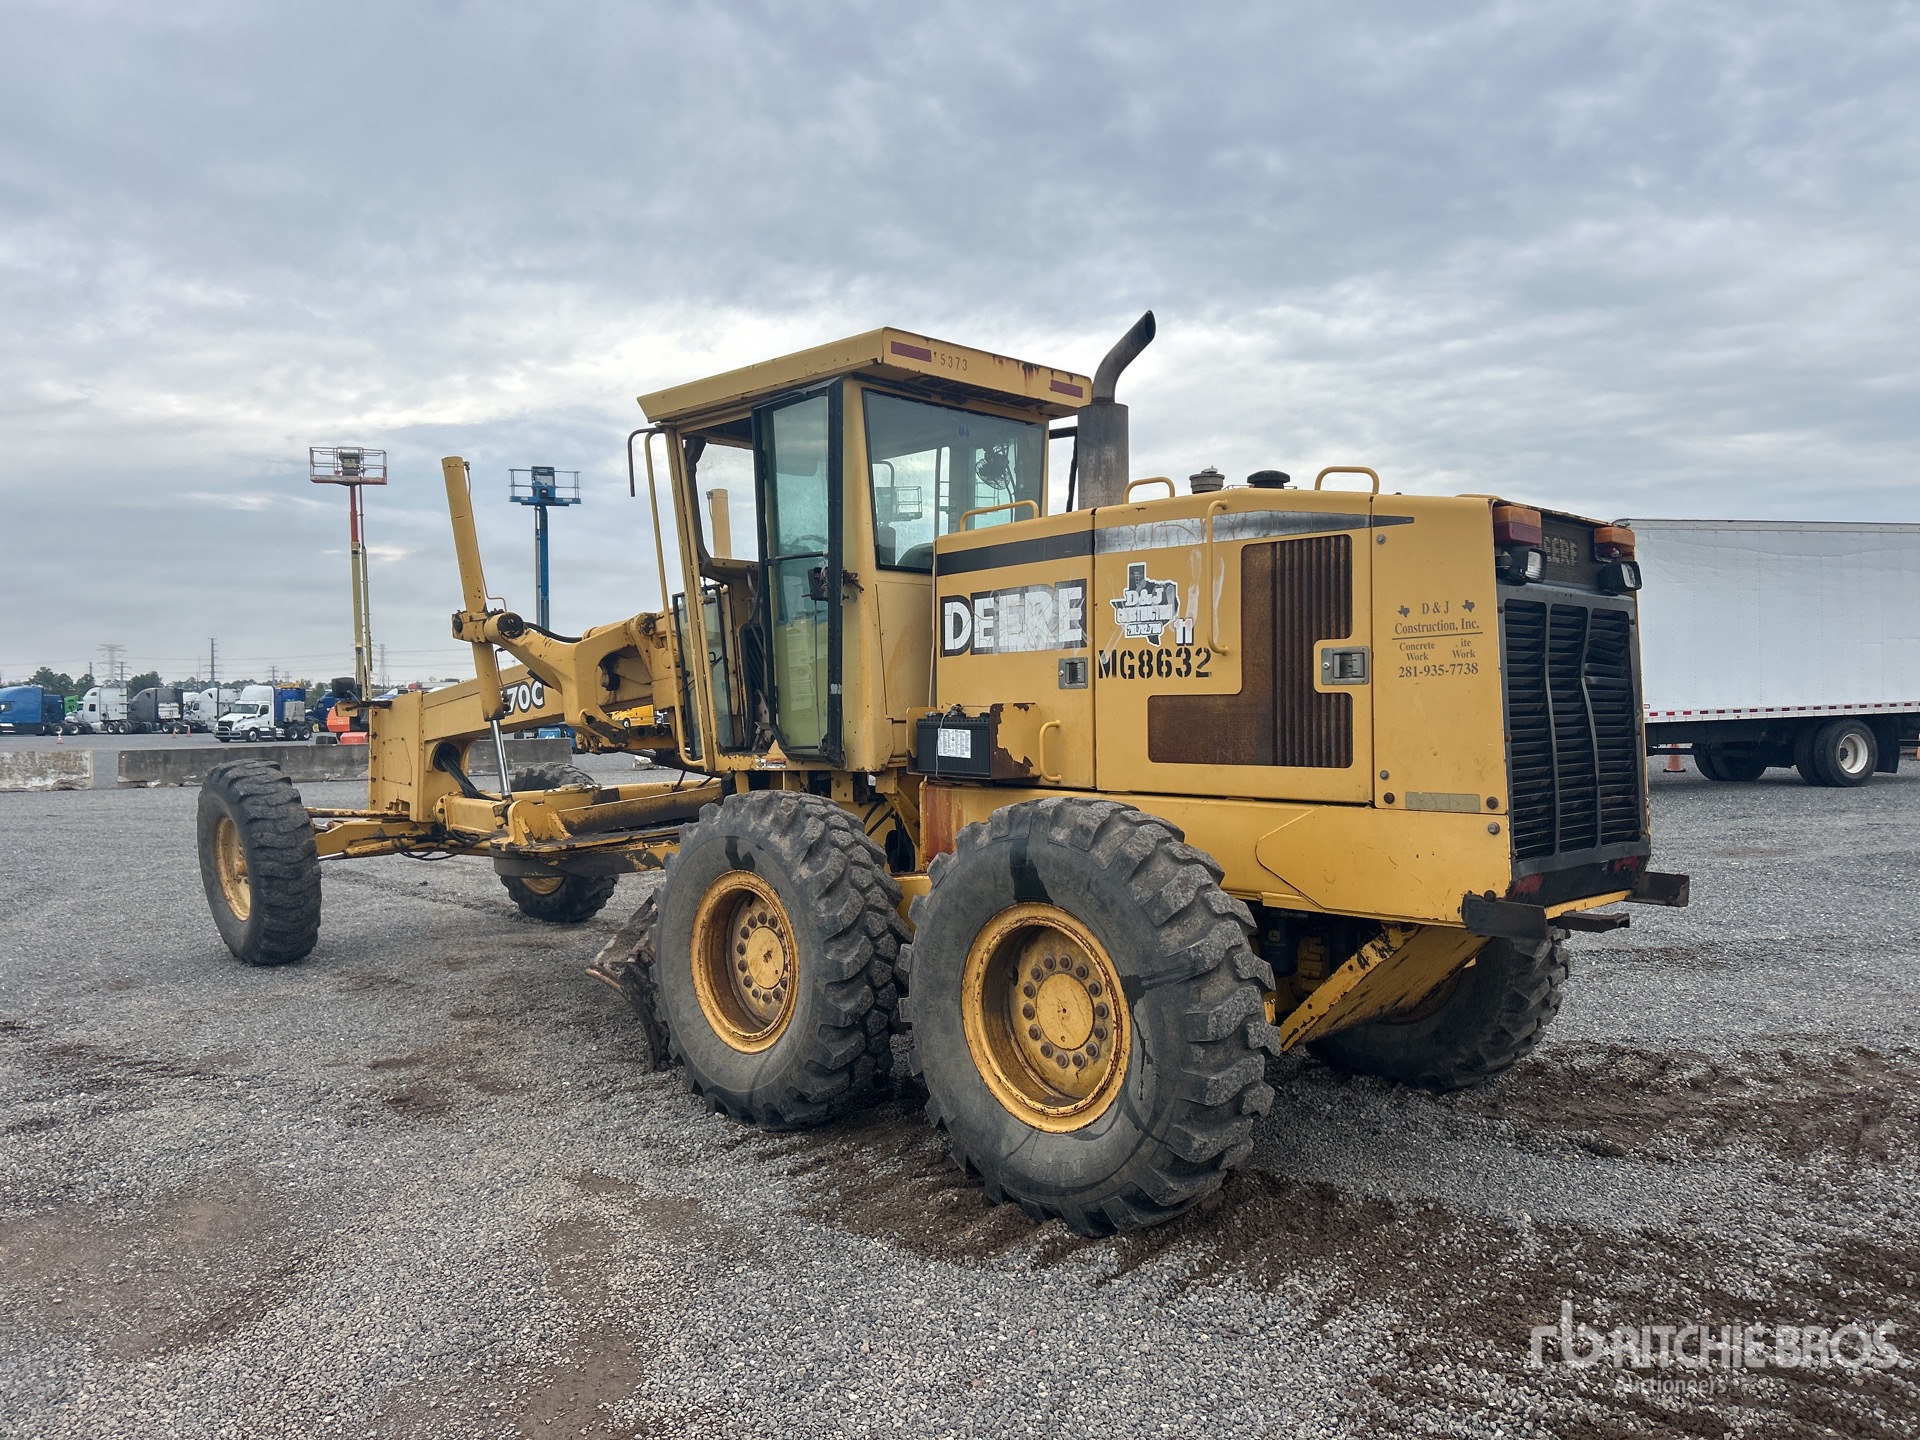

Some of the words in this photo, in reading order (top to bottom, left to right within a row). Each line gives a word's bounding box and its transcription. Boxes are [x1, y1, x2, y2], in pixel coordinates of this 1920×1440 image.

[940, 353, 968, 371] 5373
[1421, 602, 1430, 615] D
[1432, 601, 1441, 615] &
[1444, 600, 1450, 614] J
[943, 585, 1084, 653] DEERE
[1394, 619, 1459, 635] Construction,
[1461, 617, 1480, 630] Inc.
[1399, 641, 1436, 652] Concrete
[1406, 652, 1429, 662] Work
[1452, 649, 1476, 659] Work
[1098, 646, 1213, 680] MG8632
[1398, 662, 1479, 679] 281-935-7738
[501, 682, 542, 712] 70C
